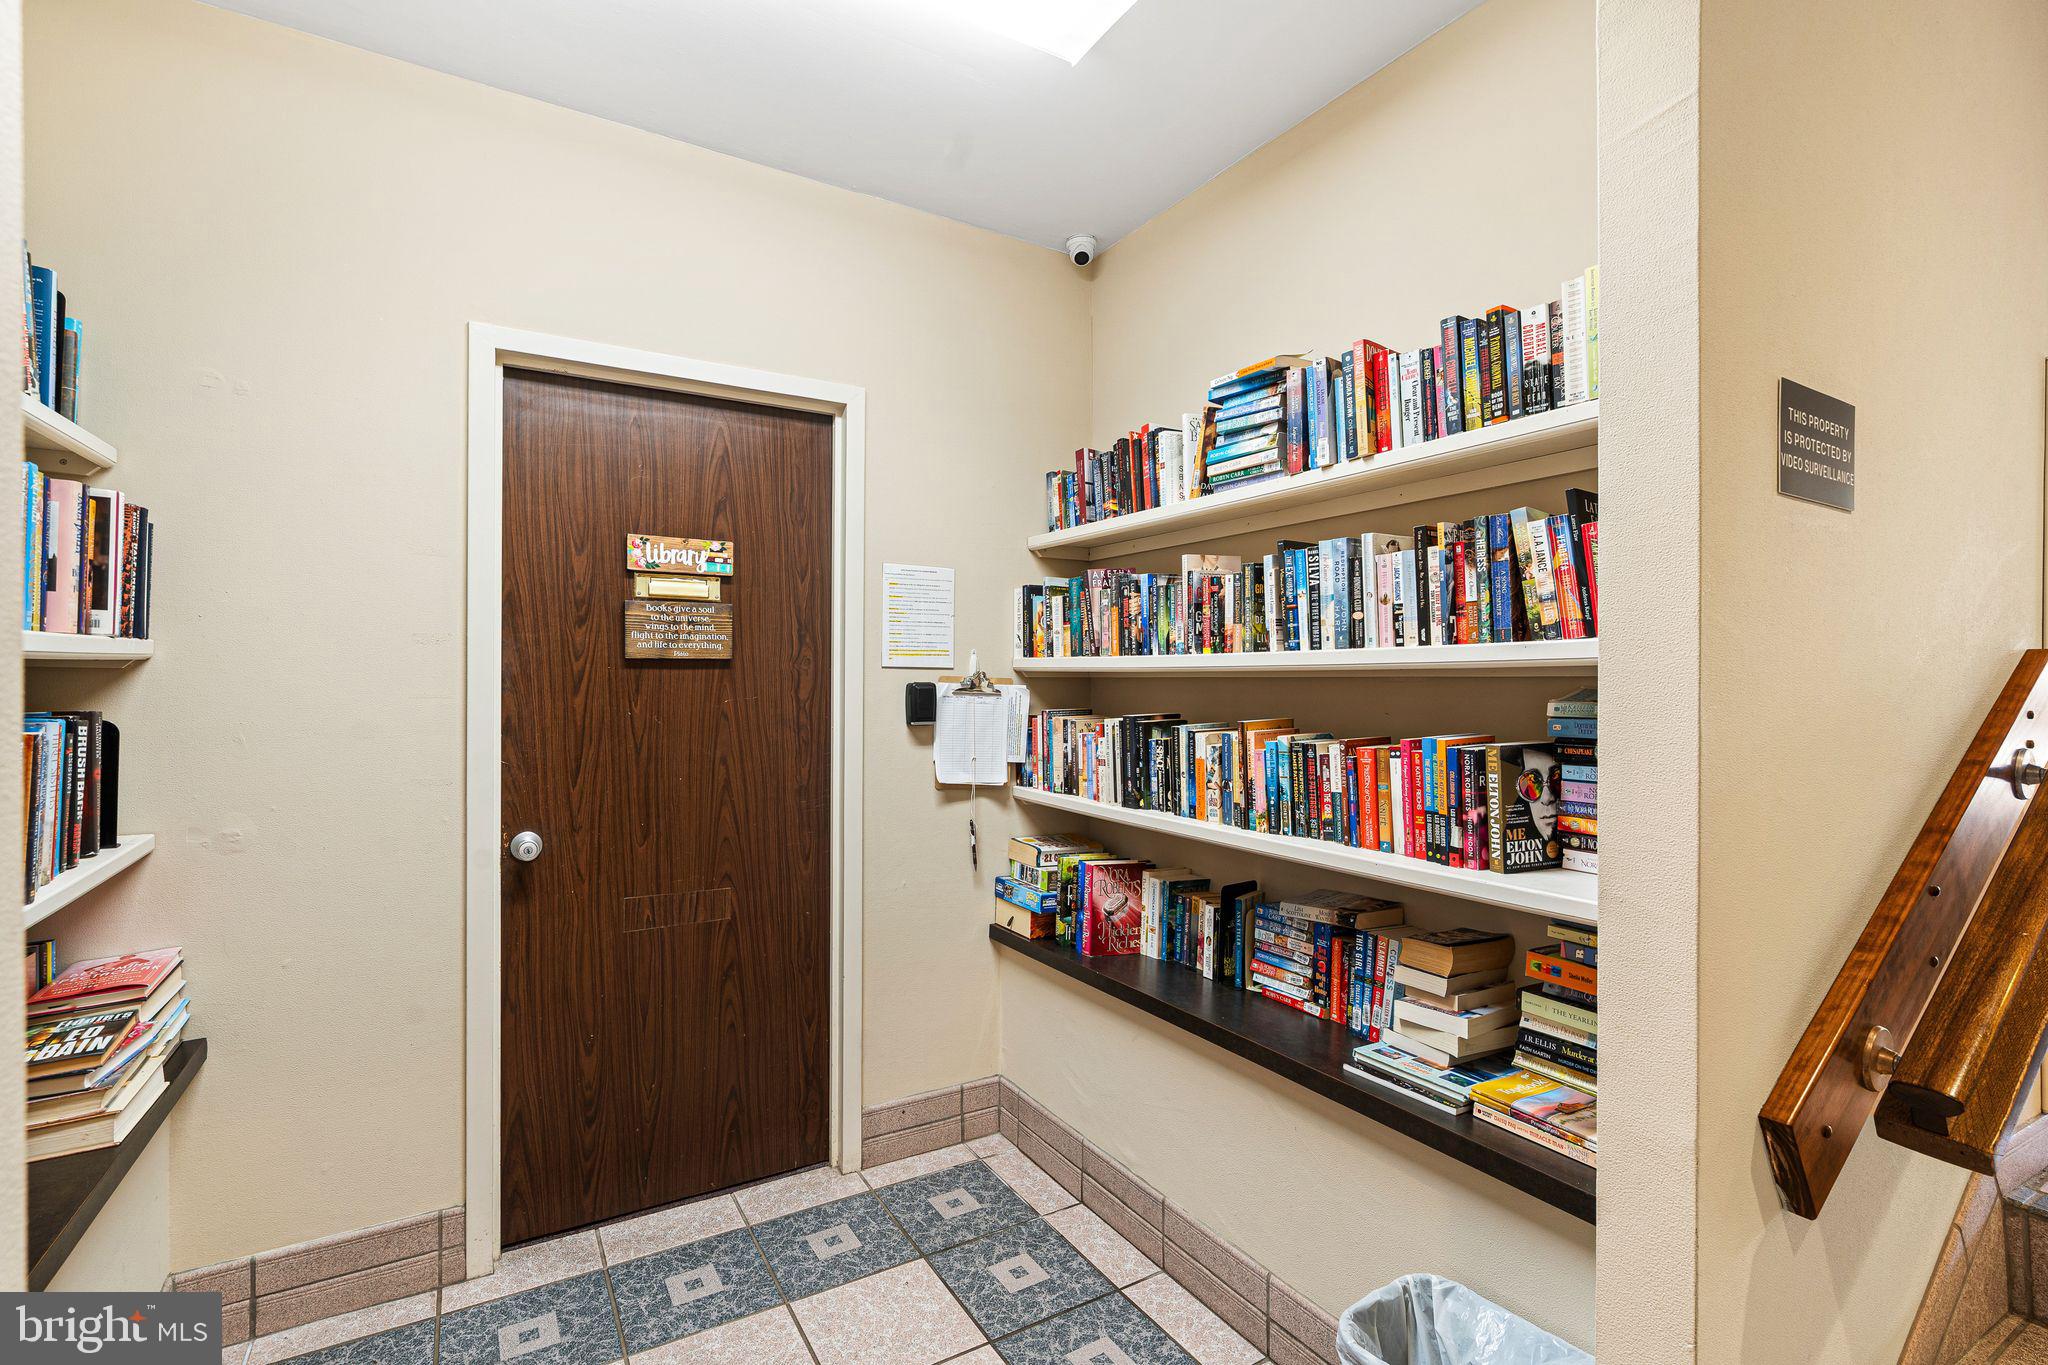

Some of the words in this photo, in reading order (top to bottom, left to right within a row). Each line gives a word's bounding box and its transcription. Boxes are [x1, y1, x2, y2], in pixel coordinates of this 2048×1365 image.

[1444, 328, 1456, 358] MICHAEL
[1490, 336, 1500, 360] PATRICIA
[1523, 324, 1534, 361] CRICHTON
[1536, 322, 1546, 356] MICHAEL
[1464, 337, 1476, 367] MICHAEL
[1446, 360, 1457, 393] CONNELLY
[1465, 369, 1478, 403] CONNELLY
[1492, 361, 1502, 389] CORNWELL
[1525, 375, 1548, 388] STATE
[1404, 399, 1412, 422] Danger
[1788, 407, 1807, 426] THIS
[1809, 414, 1850, 440] PROPERTY
[1784, 430, 1792, 444] IS
[1794, 433, 1840, 460] PROTECTED
[1842, 449, 1852, 463] BY
[1213, 474, 1230, 482] ROBYN
[1230, 470, 1245, 479] CARR
[1781, 452, 1803, 470] VIDEO
[1804, 460, 1854, 486] SURVEILLANCE
[646, 542, 708, 572] library
[1476, 539, 1486, 572] HEIRESS
[1535, 549, 1547, 572] JANCE
[1557, 534, 1568, 571] VENDETTA
[1308, 556, 1320, 586] SILVA
[1286, 567, 1294, 602] EX-HUSBAND
[673, 606, 690, 614] give
[1583, 606, 1592, 620] Karpf
[631, 631, 654, 640] flight
[77, 726, 88, 778] BRUSH
[1488, 748, 1497, 772] ME
[1564, 748, 1594, 756] CHESAPEAKE
[1307, 758, 1315, 780] JAMES
[77, 781, 85, 820] BACK
[1308, 781, 1317, 819] PATTERSON
[1488, 774, 1499, 818] ELTON
[1490, 819, 1500, 858] JOHN
[1506, 828, 1526, 841] ME
[1506, 838, 1543, 854] ELTON
[1506, 851, 1543, 866] JOHN
[1099, 866, 1130, 882] NORA
[1094, 878, 1142, 898] ROBERTS
[1102, 935, 1142, 953] Riches
[1355, 953, 1364, 970] GIRL
[1376, 941, 1385, 976] SLAMMED
[1387, 950, 1396, 991] CONFESS
[1568, 972, 1580, 981] Sheila
[1266, 990, 1279, 999] ROBYN
[1280, 995, 1292, 1004] CARR
[1552, 1008, 1567, 1018] THE
[1568, 1012, 1598, 1027] YEARLIN
[64, 1025, 106, 1042] ED
[1535, 1037, 1557, 1051] ELLIS
[1519, 1044, 1532, 1053] FAITH
[1533, 1048, 1551, 1059] MARTIN
[1558, 1058, 1575, 1068] MURDER
[1561, 1046, 1586, 1060] Murder
[1507, 1121, 1516, 1130] FAY
[1529, 1130, 1551, 1145] MIRACLE
[1552, 1140, 1564, 1149] MAN
